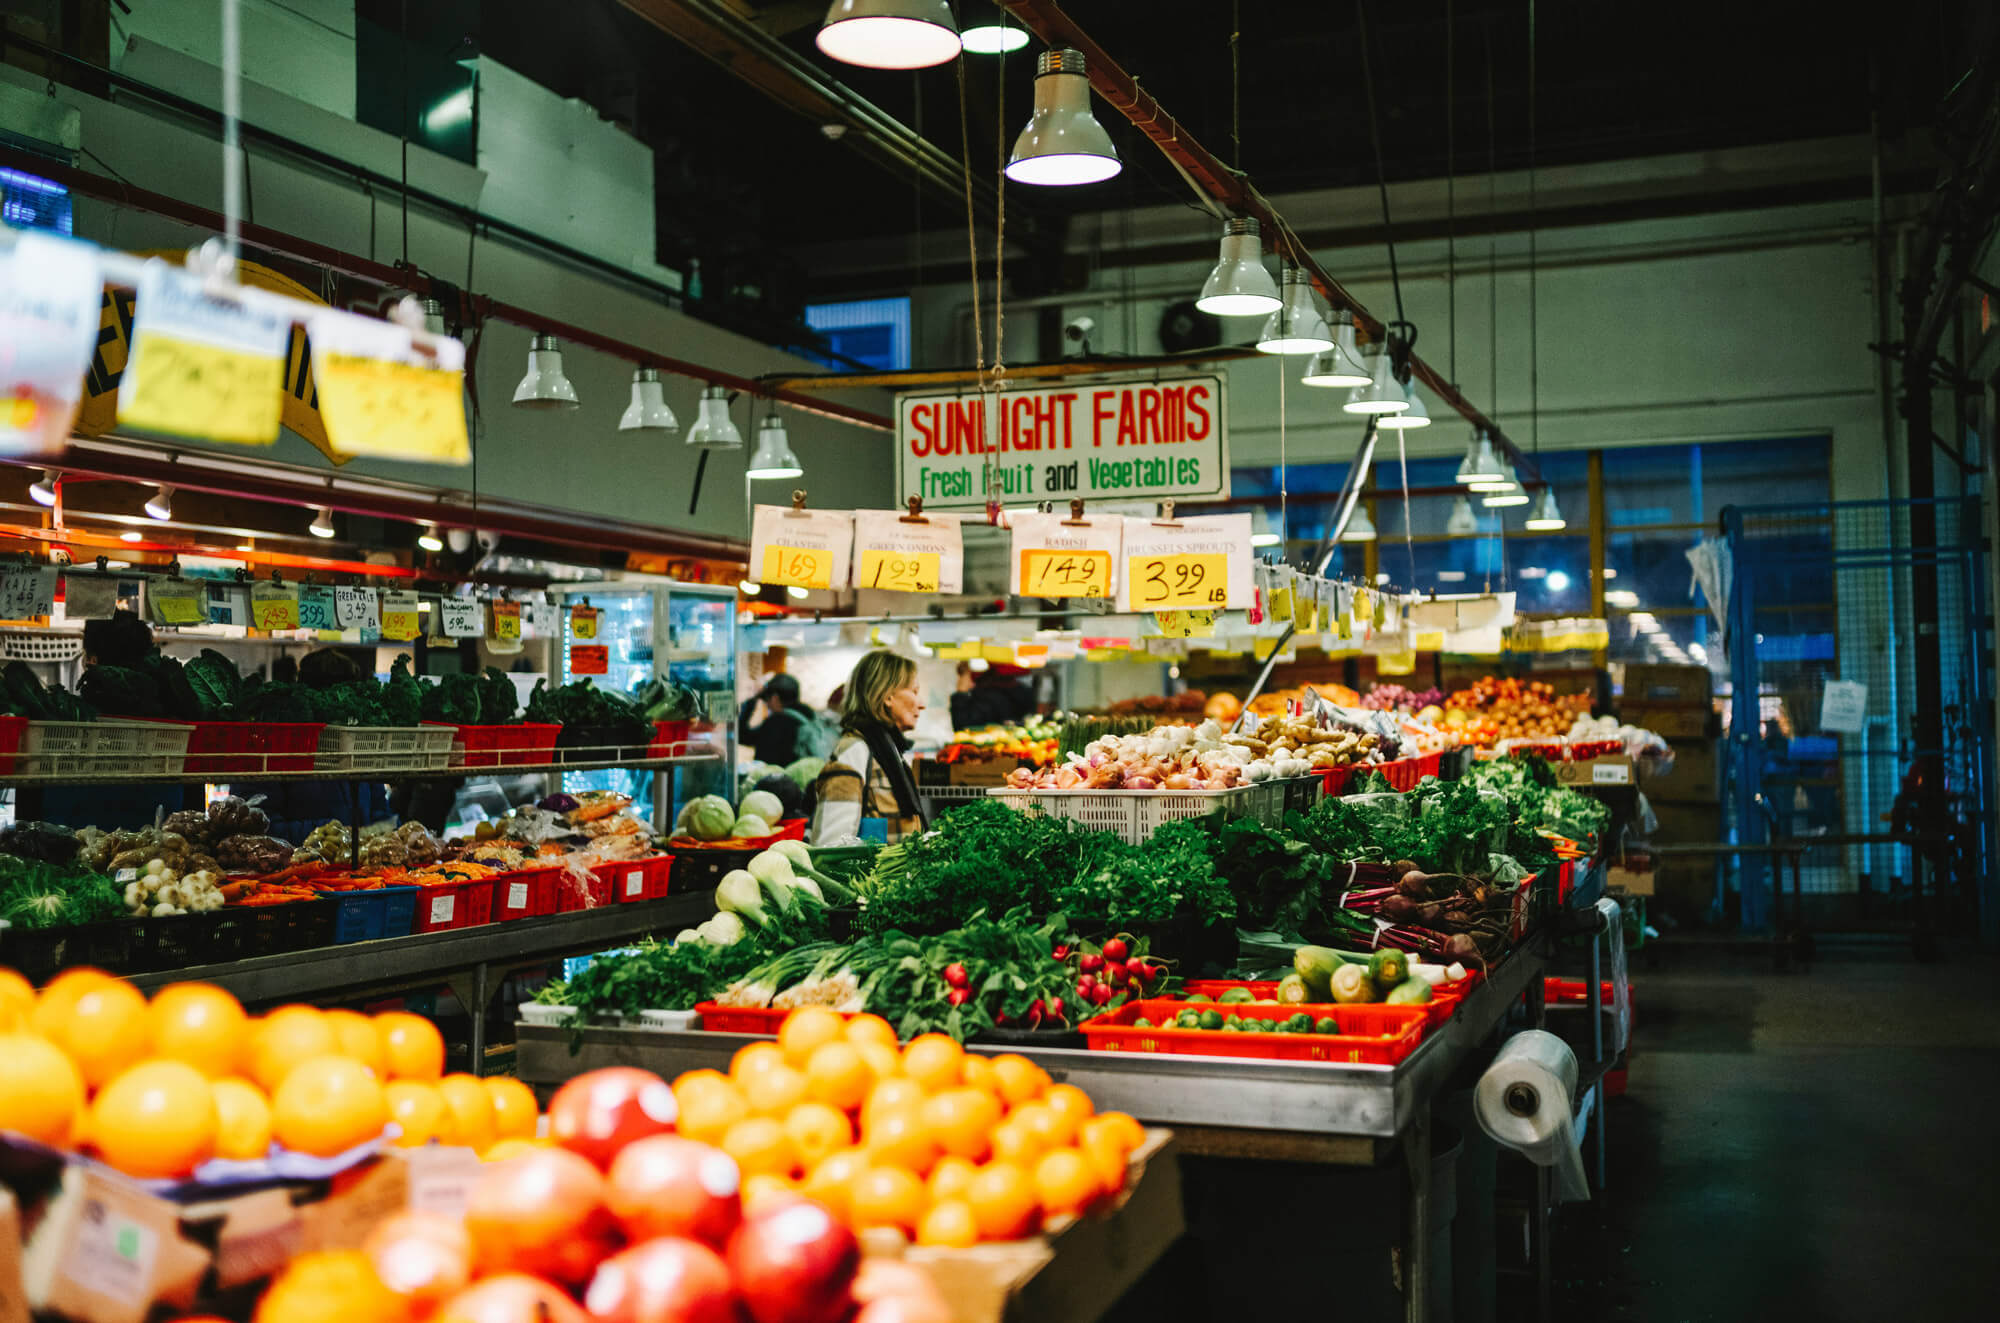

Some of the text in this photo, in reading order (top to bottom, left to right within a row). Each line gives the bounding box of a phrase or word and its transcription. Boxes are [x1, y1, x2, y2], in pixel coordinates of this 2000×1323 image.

[910, 385, 1210, 458] SUNLIGHT FARMS
[920, 466, 972, 499] Fresh
[1045, 459, 1078, 492] and
[1088, 456, 1200, 490] Vegetables
[1186, 542, 1237, 554] SPROUTS
[1208, 588, 1226, 602] LB
